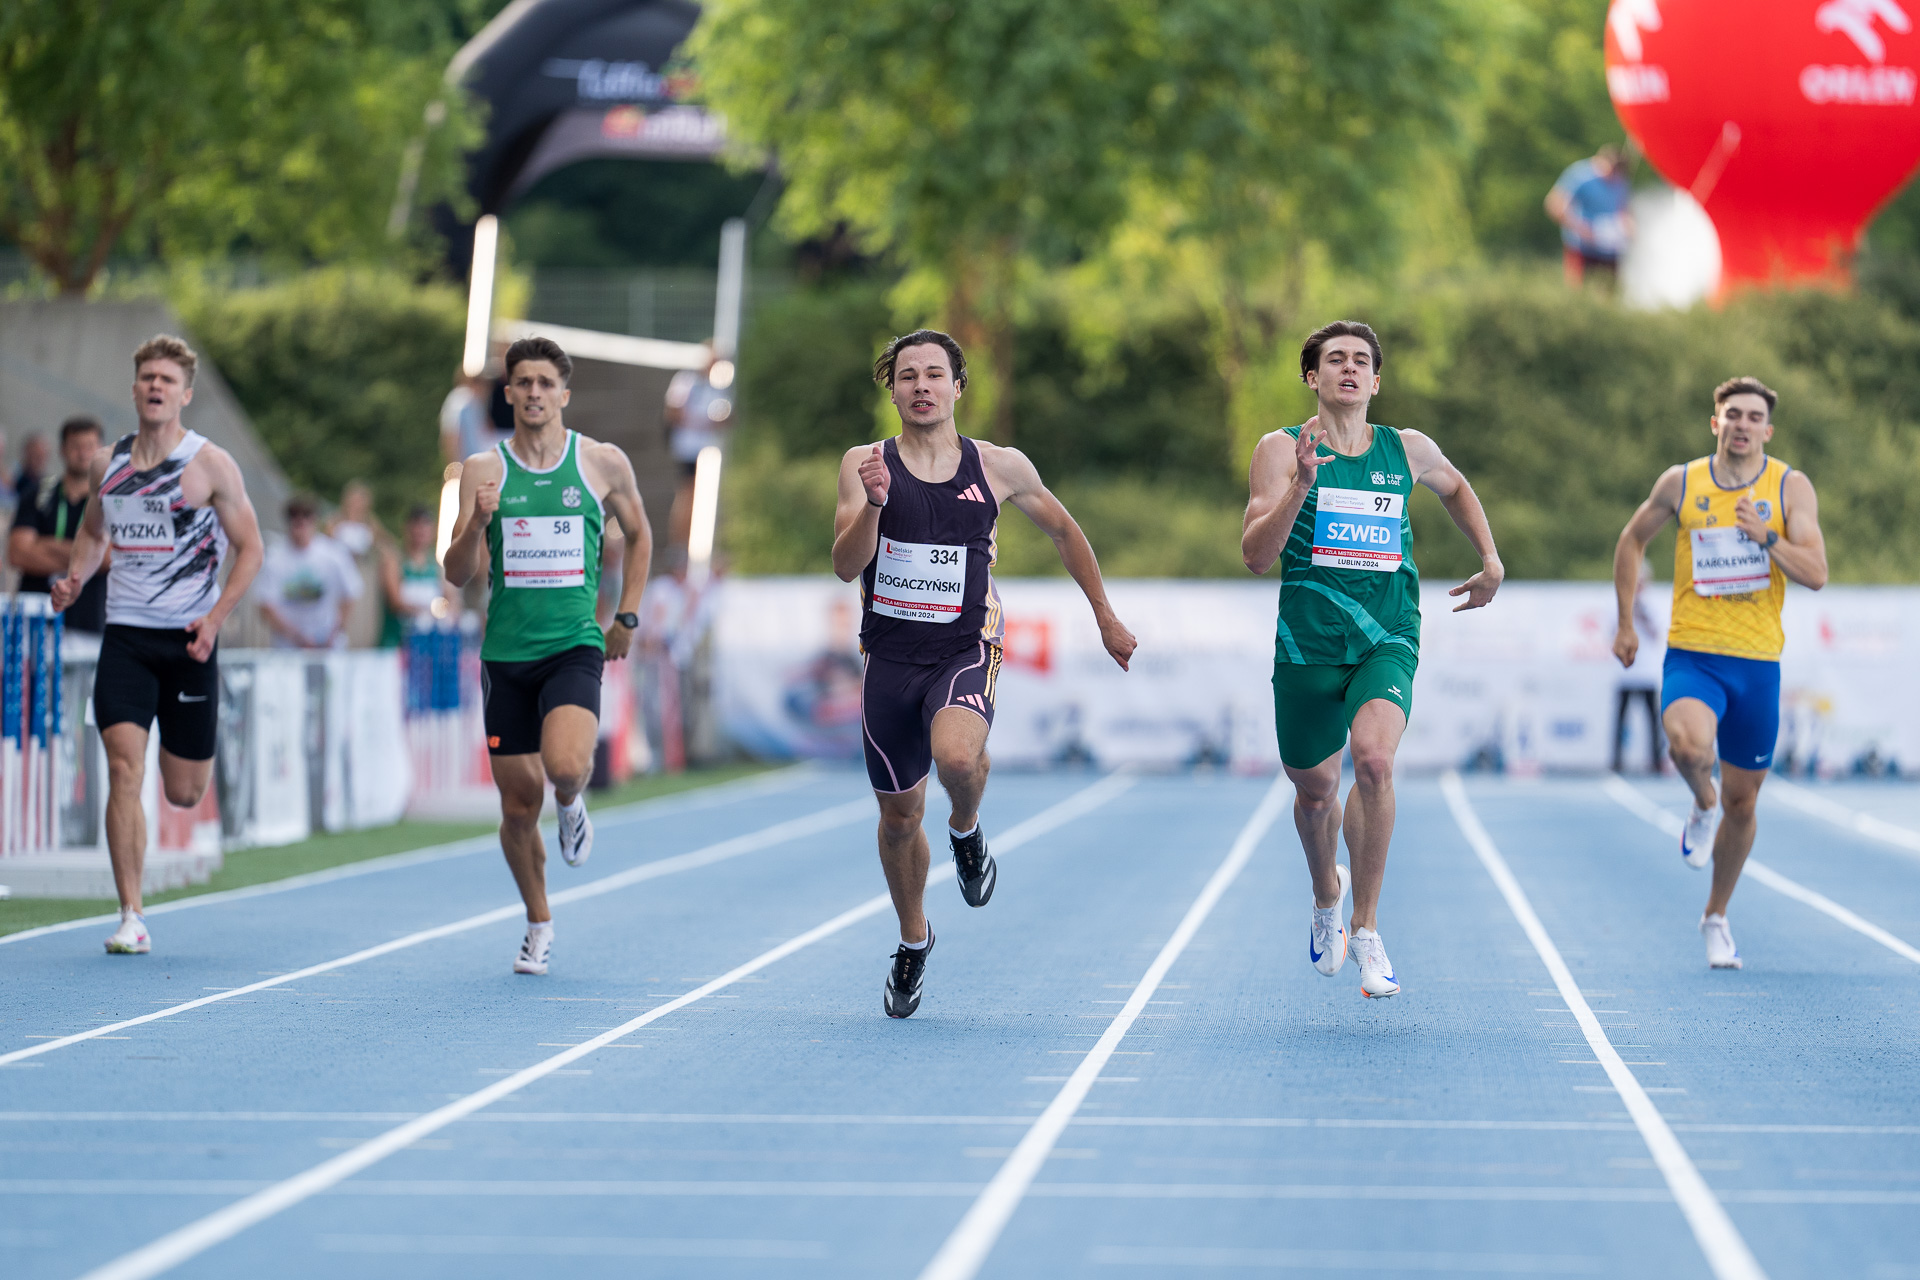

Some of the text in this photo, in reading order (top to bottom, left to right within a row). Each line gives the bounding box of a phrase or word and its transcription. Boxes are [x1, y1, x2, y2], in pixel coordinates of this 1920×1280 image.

[143, 499, 164, 514] 352
[1374, 497, 1391, 512] 97
[554, 520, 571, 534] 58
[1326, 522, 1391, 544] SZWED
[506, 548, 581, 559] GRZEGORZEWICZ
[886, 542, 912, 554] Lubelskie
[930, 549, 958, 565] 334
[878, 572, 961, 593] BOGACZYŃSKI
[894, 601, 929, 609] MISTRZOSTWA
[893, 608, 935, 619] LUBLIN 2024
